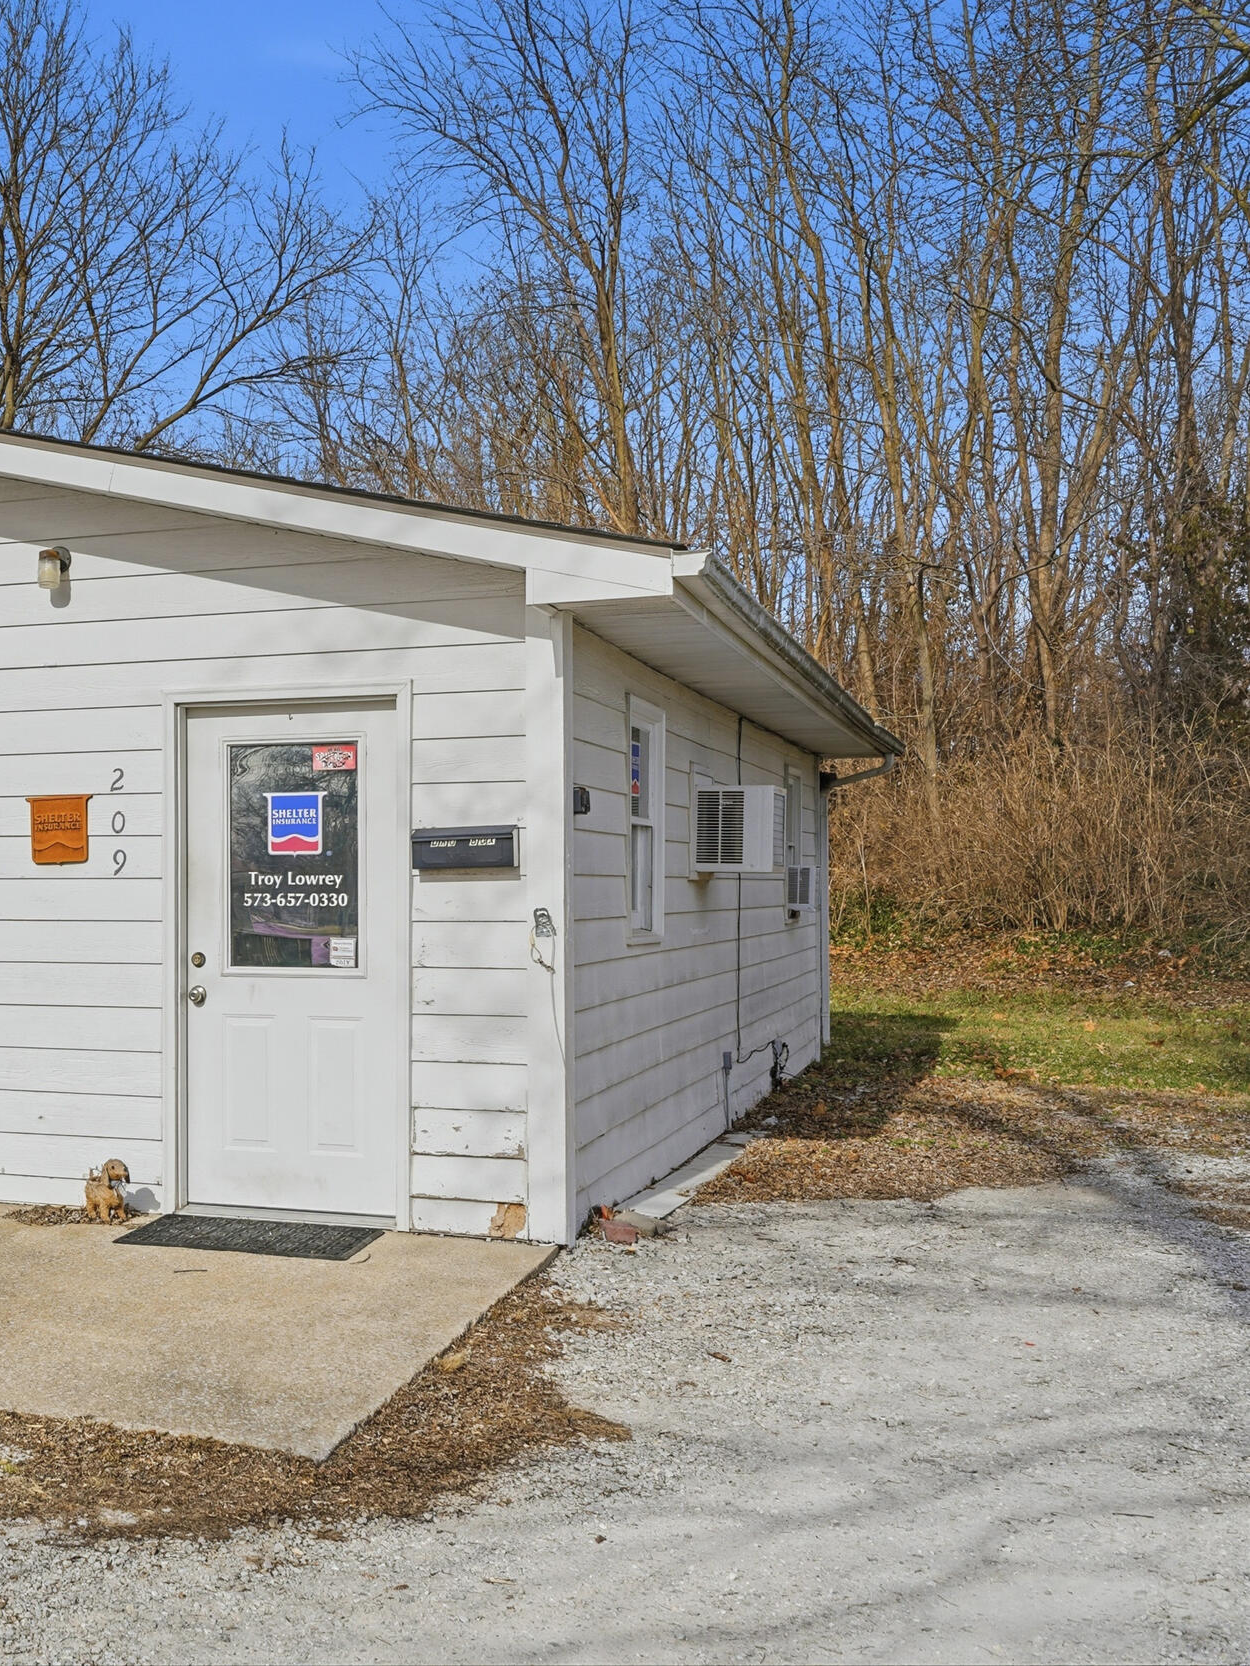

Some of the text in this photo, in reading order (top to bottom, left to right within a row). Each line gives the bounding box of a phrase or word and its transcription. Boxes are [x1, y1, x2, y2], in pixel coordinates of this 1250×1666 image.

[34, 812, 82, 824] SHELTER
[273, 808, 317, 819] SHELTER
[34, 821, 82, 833] INSURANCE
[248, 871, 343, 888] Troy Lowrey
[243, 892, 348, 907] 573-657-0330
